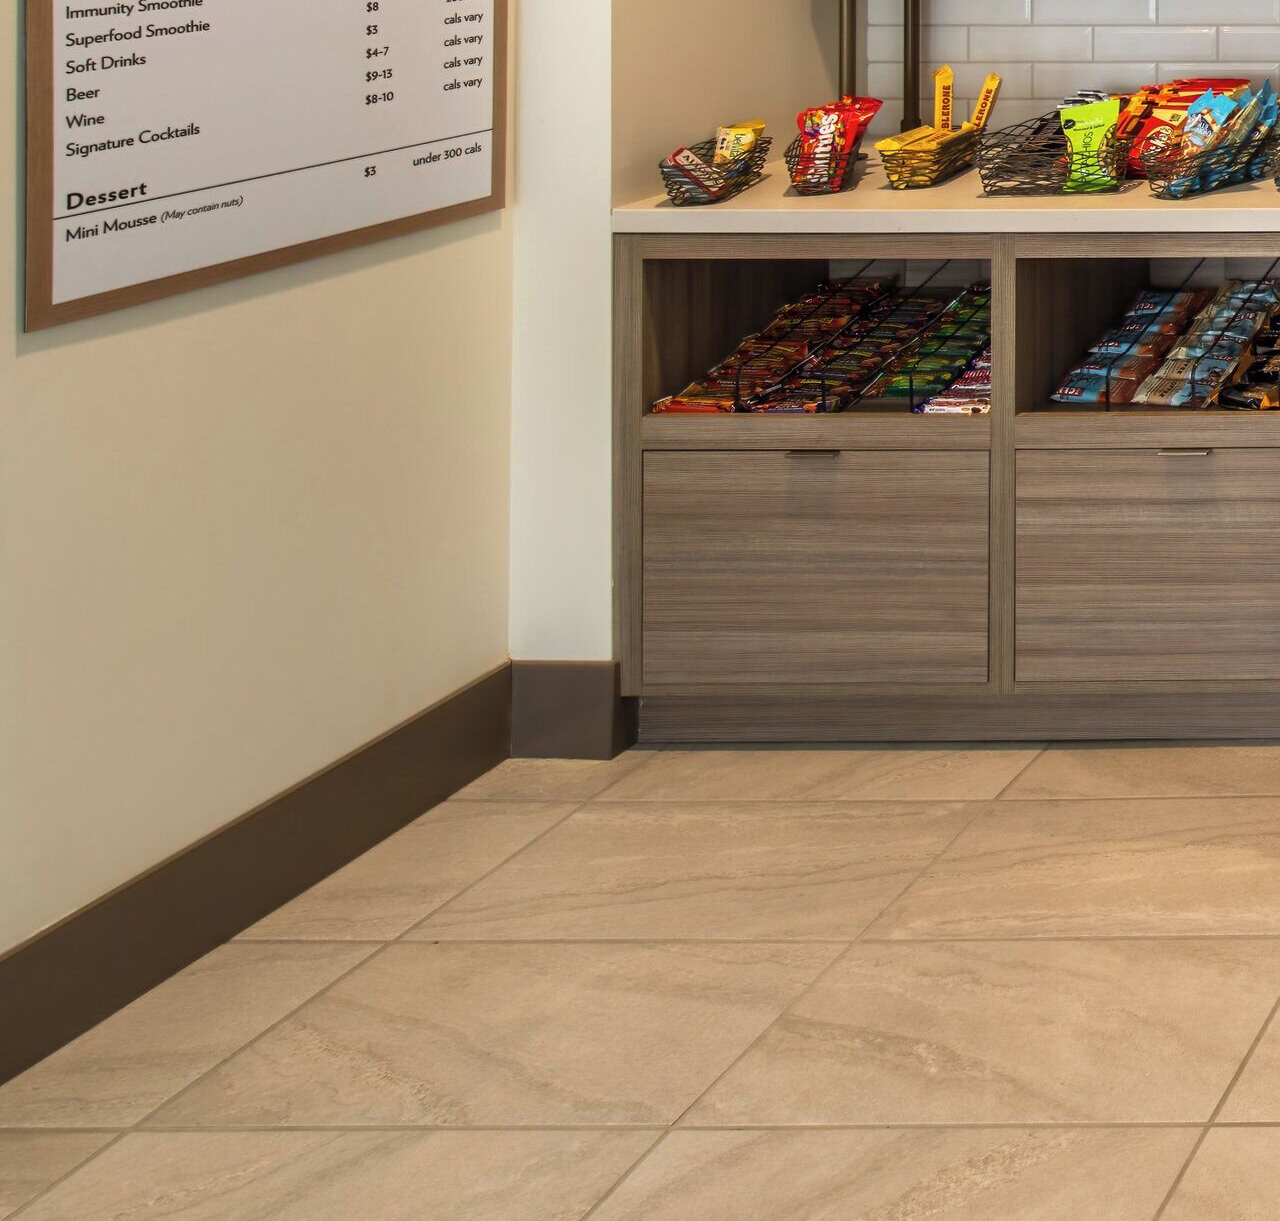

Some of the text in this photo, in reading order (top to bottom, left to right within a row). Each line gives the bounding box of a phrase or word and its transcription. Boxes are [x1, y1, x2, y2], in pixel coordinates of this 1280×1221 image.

[365, 0, 379, 13] $8
[65, 19, 210, 48] Superfood Smoothie
[364, 90, 394, 106] $8-10
[442, 77, 483, 91] cals vary
[941, 84, 951, 130] BLERONE
[65, 122, 200, 158] Signature Cocktails
[66, 182, 147, 211] Dessert
